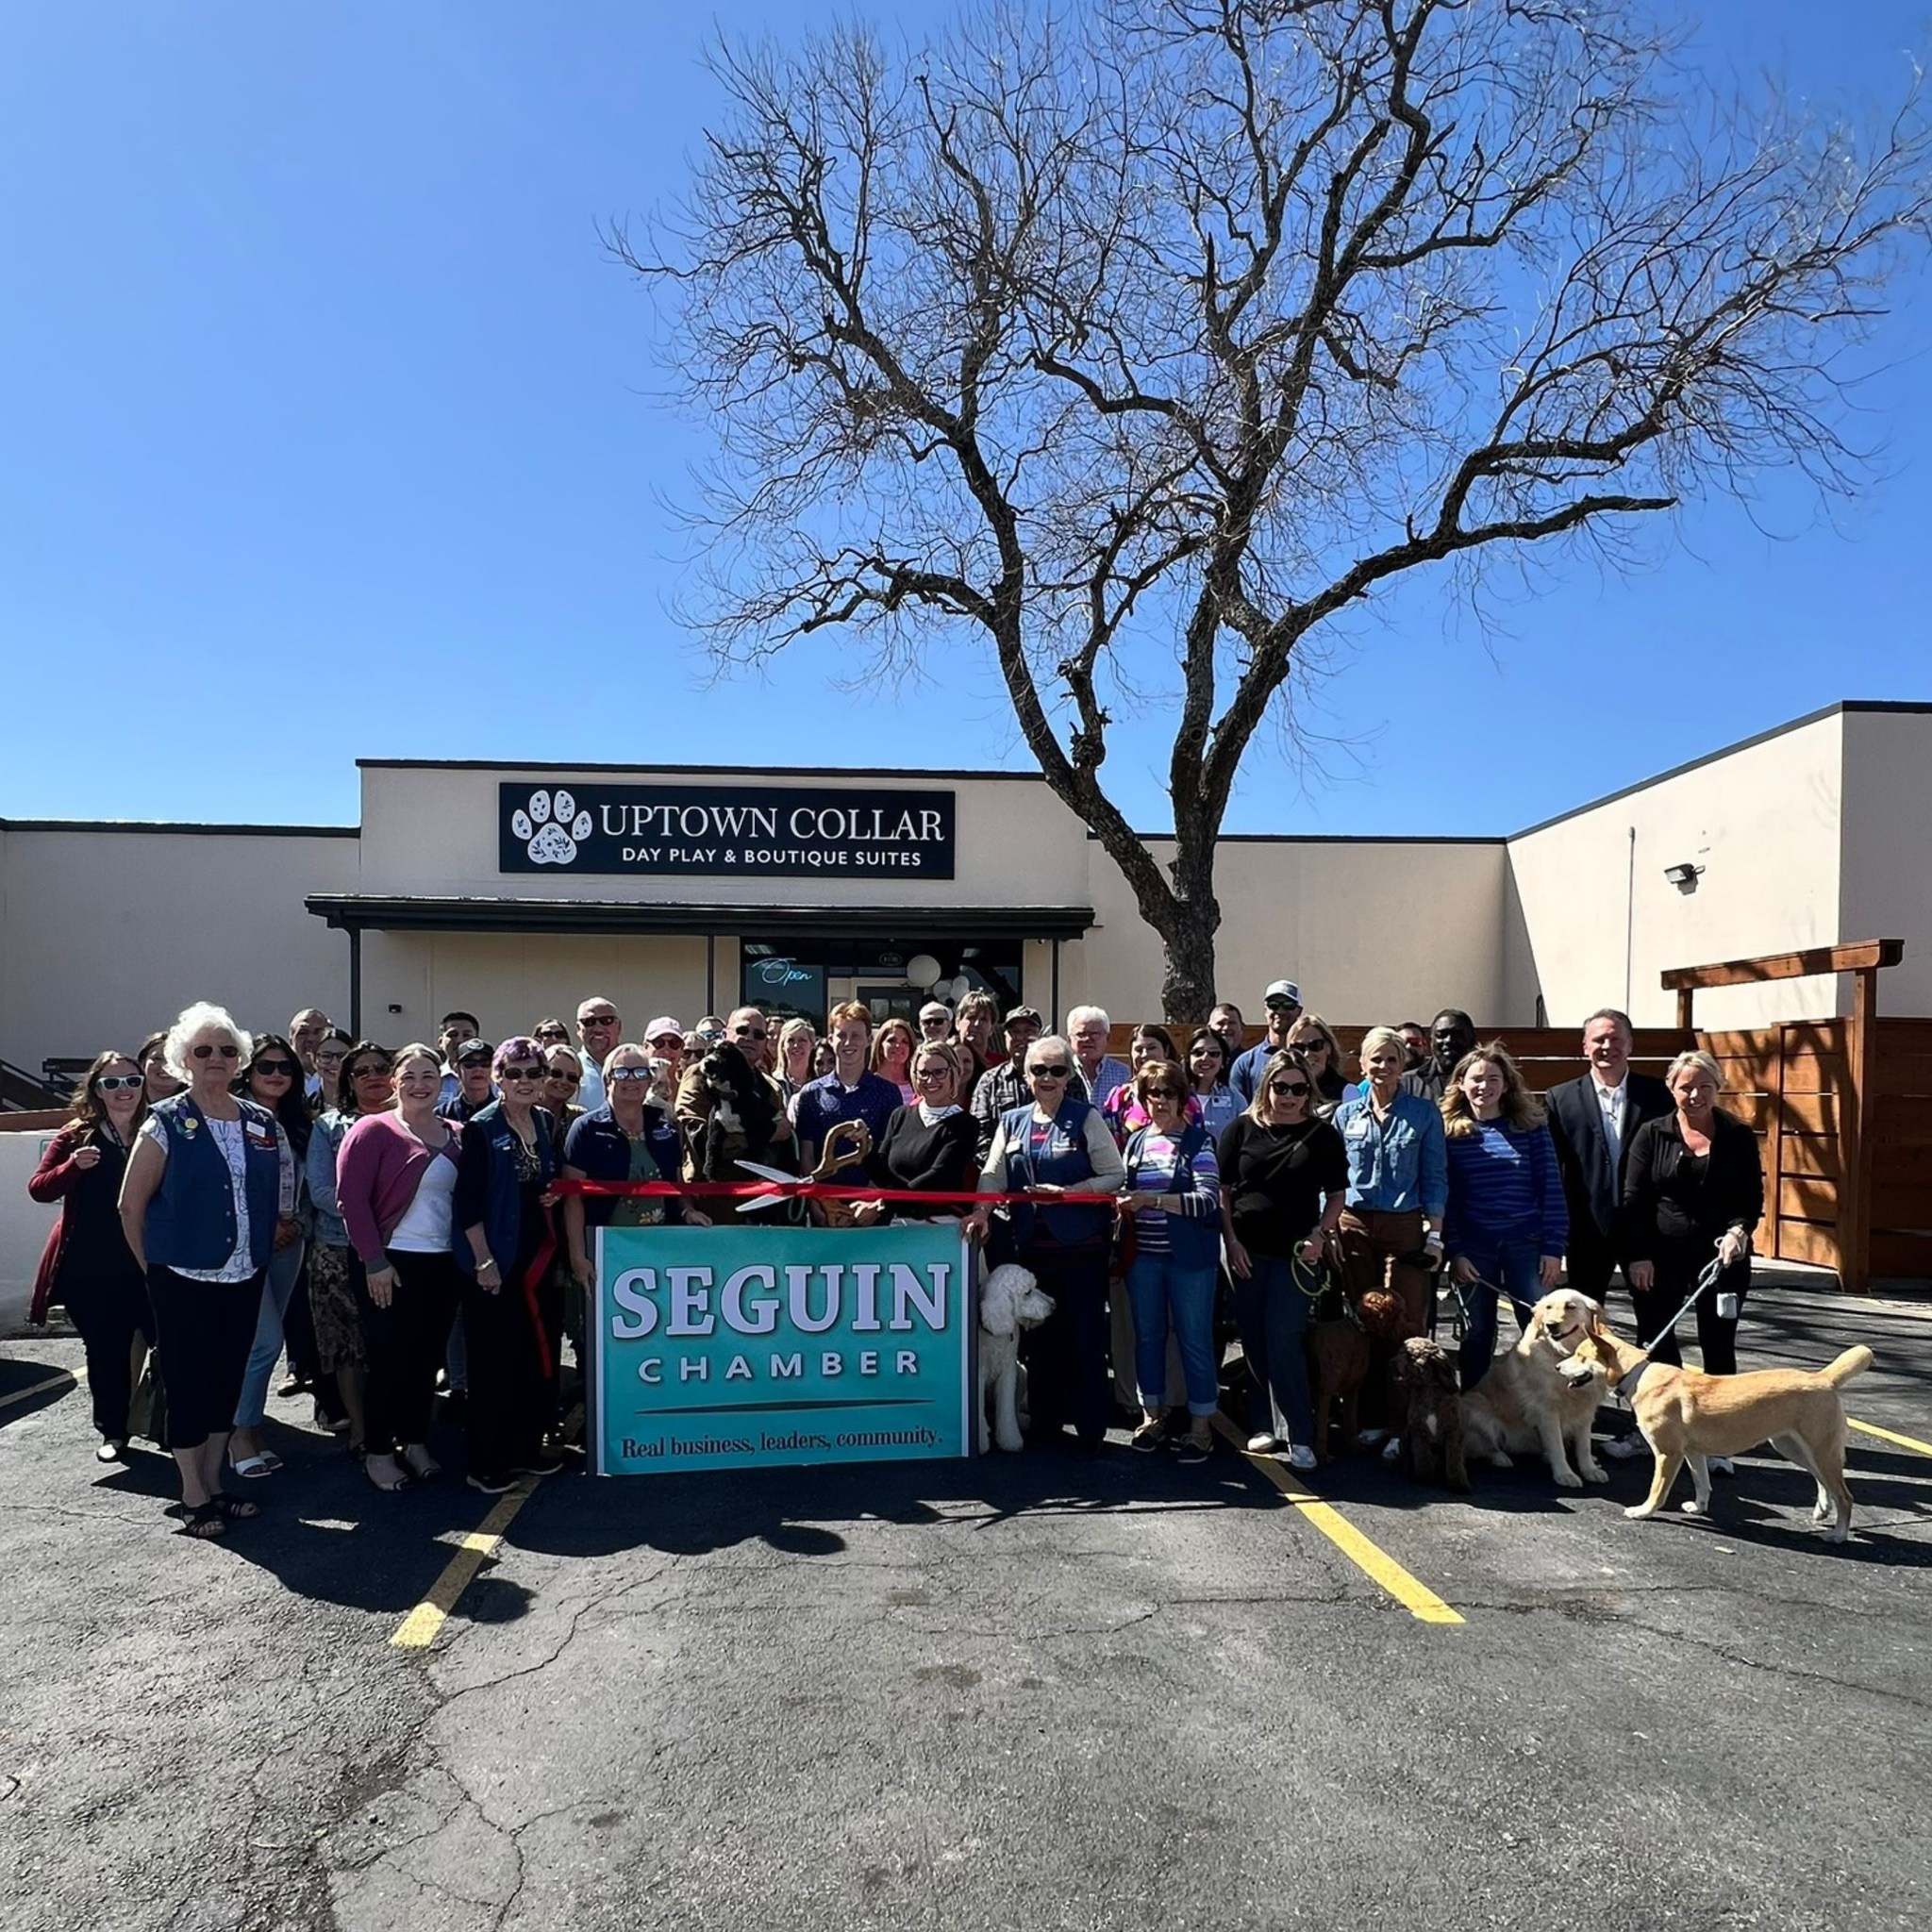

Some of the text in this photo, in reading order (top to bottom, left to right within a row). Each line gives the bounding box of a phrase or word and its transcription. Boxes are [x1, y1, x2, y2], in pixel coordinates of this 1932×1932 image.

[600, 805, 944, 841] UPTOWN COLLAR
[623, 848, 921, 866] DAY PLAY & BOUTIQUE SUITES
[752, 958, 812, 986] Open
[612, 1264, 950, 1339] SEGUIN
[638, 1351, 918, 1383] CHAMBER
[622, 1425, 943, 1457] Real business, leaders, community.
